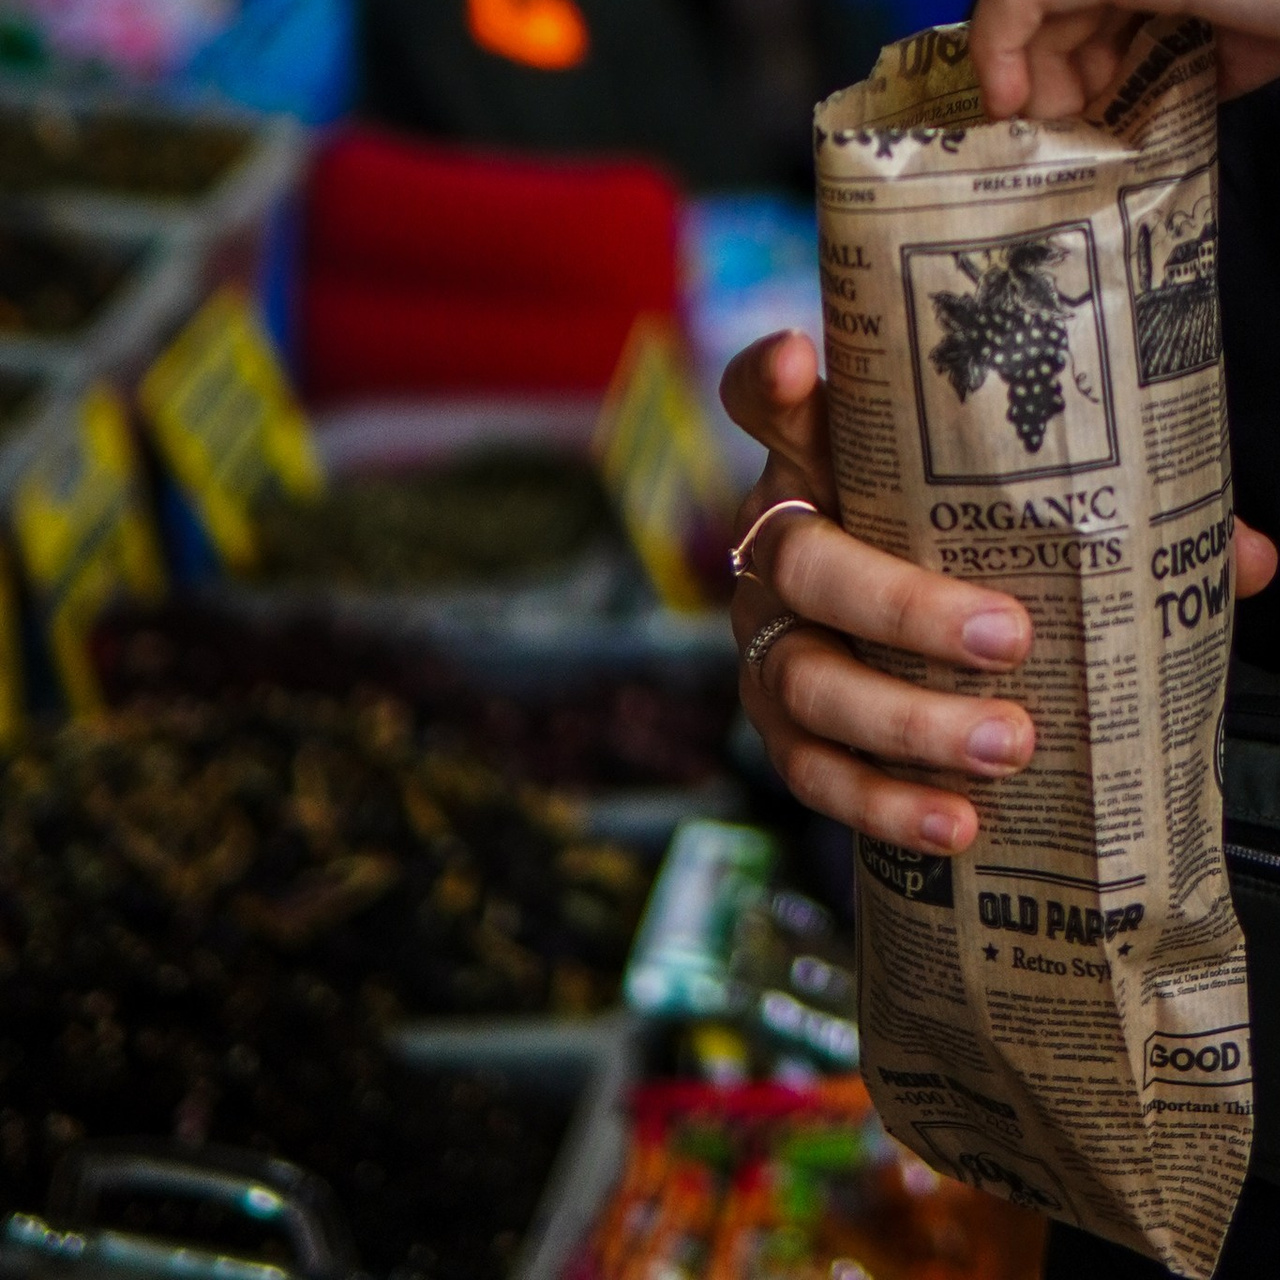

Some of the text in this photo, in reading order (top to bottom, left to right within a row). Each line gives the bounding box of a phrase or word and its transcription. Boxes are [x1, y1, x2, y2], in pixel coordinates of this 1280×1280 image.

[972, 176, 1022, 193] PRICE
[1045, 168, 1098, 186] CENTS
[929, 485, 1117, 533] ORGANIC
[940, 537, 1123, 573] PRODUCTS
[978, 892, 1039, 936] OLD
[1045, 903, 1146, 947] PAPER
[1011, 946, 1113, 984] Retro Styl
[1150, 1042, 1240, 1072] GOOD
[1223, 1100, 1254, 1116] Thi
